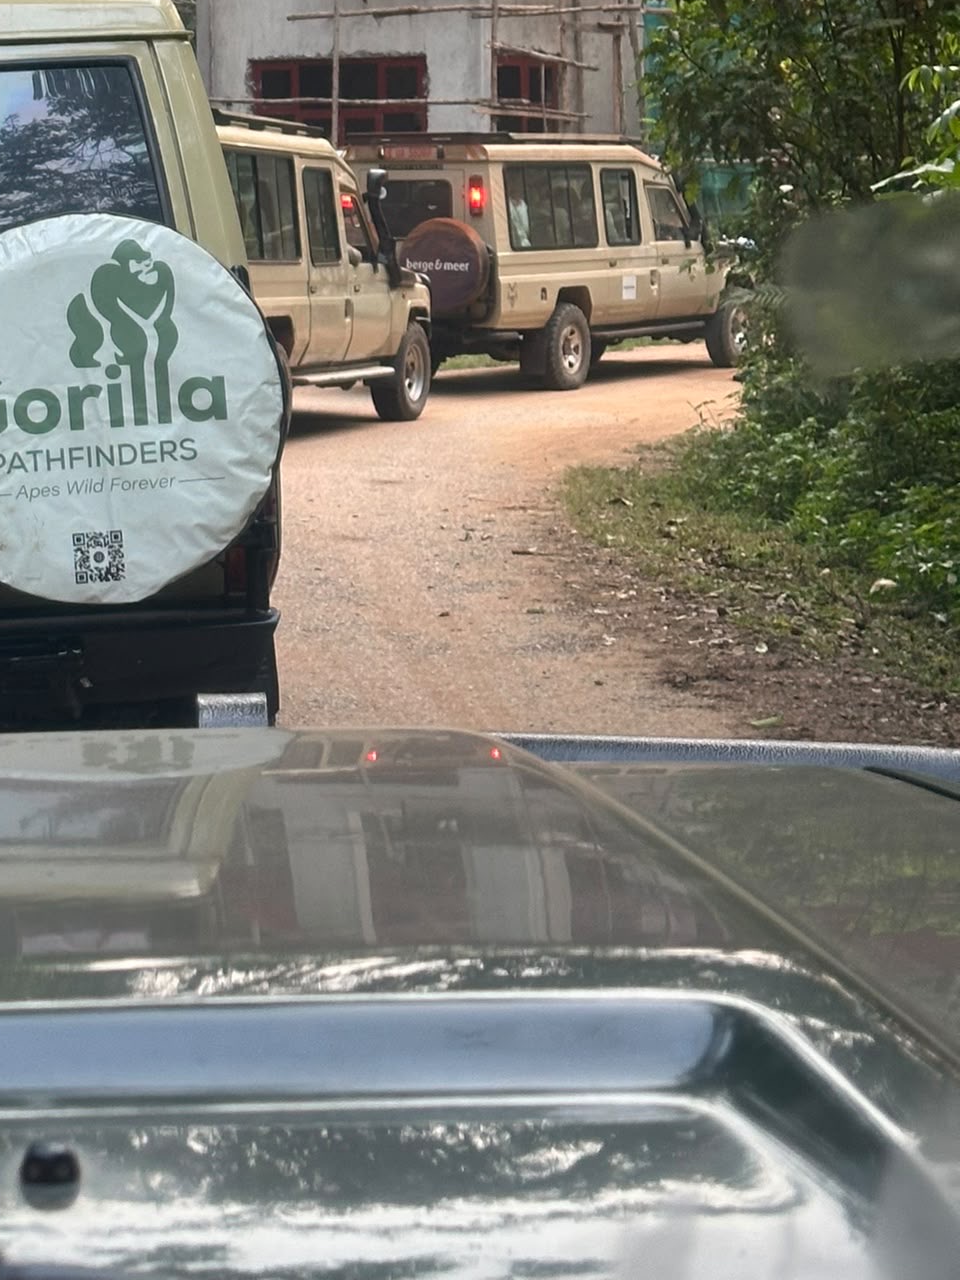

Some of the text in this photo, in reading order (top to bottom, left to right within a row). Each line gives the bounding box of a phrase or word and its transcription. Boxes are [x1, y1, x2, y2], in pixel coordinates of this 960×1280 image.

[443, 261, 470, 272] meer
[15, 476, 176, 503] Apes Wild Forever
